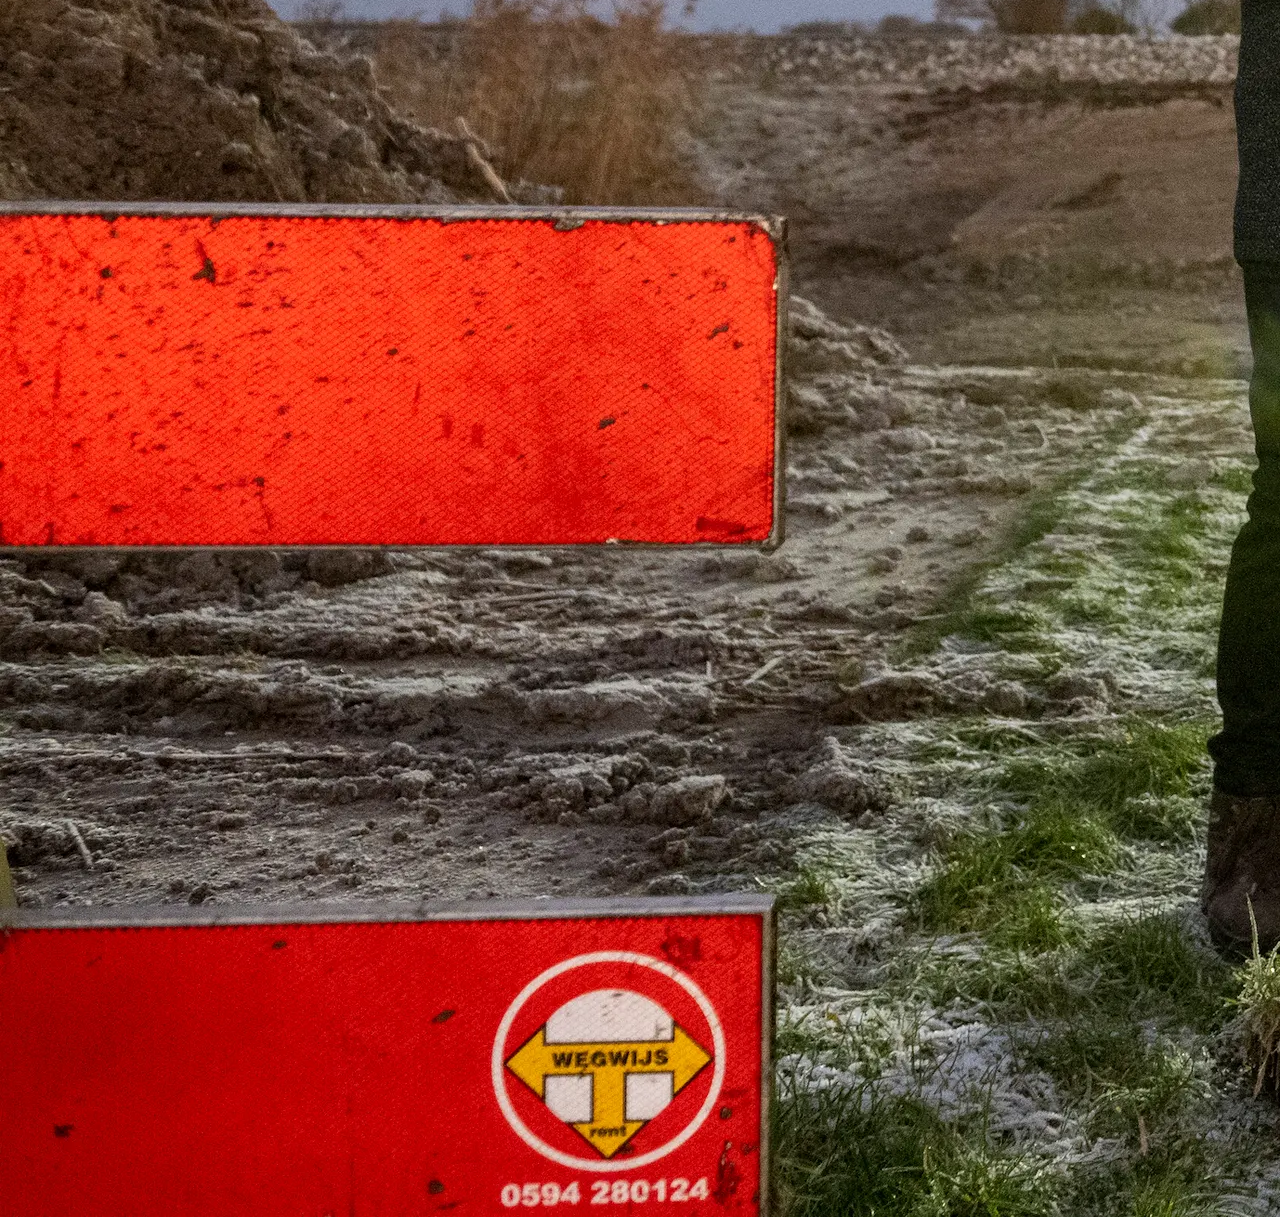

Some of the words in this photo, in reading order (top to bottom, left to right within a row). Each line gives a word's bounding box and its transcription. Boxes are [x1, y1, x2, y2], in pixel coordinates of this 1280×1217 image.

[552, 1050, 669, 1067] WEGWIJS
[500, 1181, 581, 1207] 0594
[590, 1177, 710, 1205] 280124
